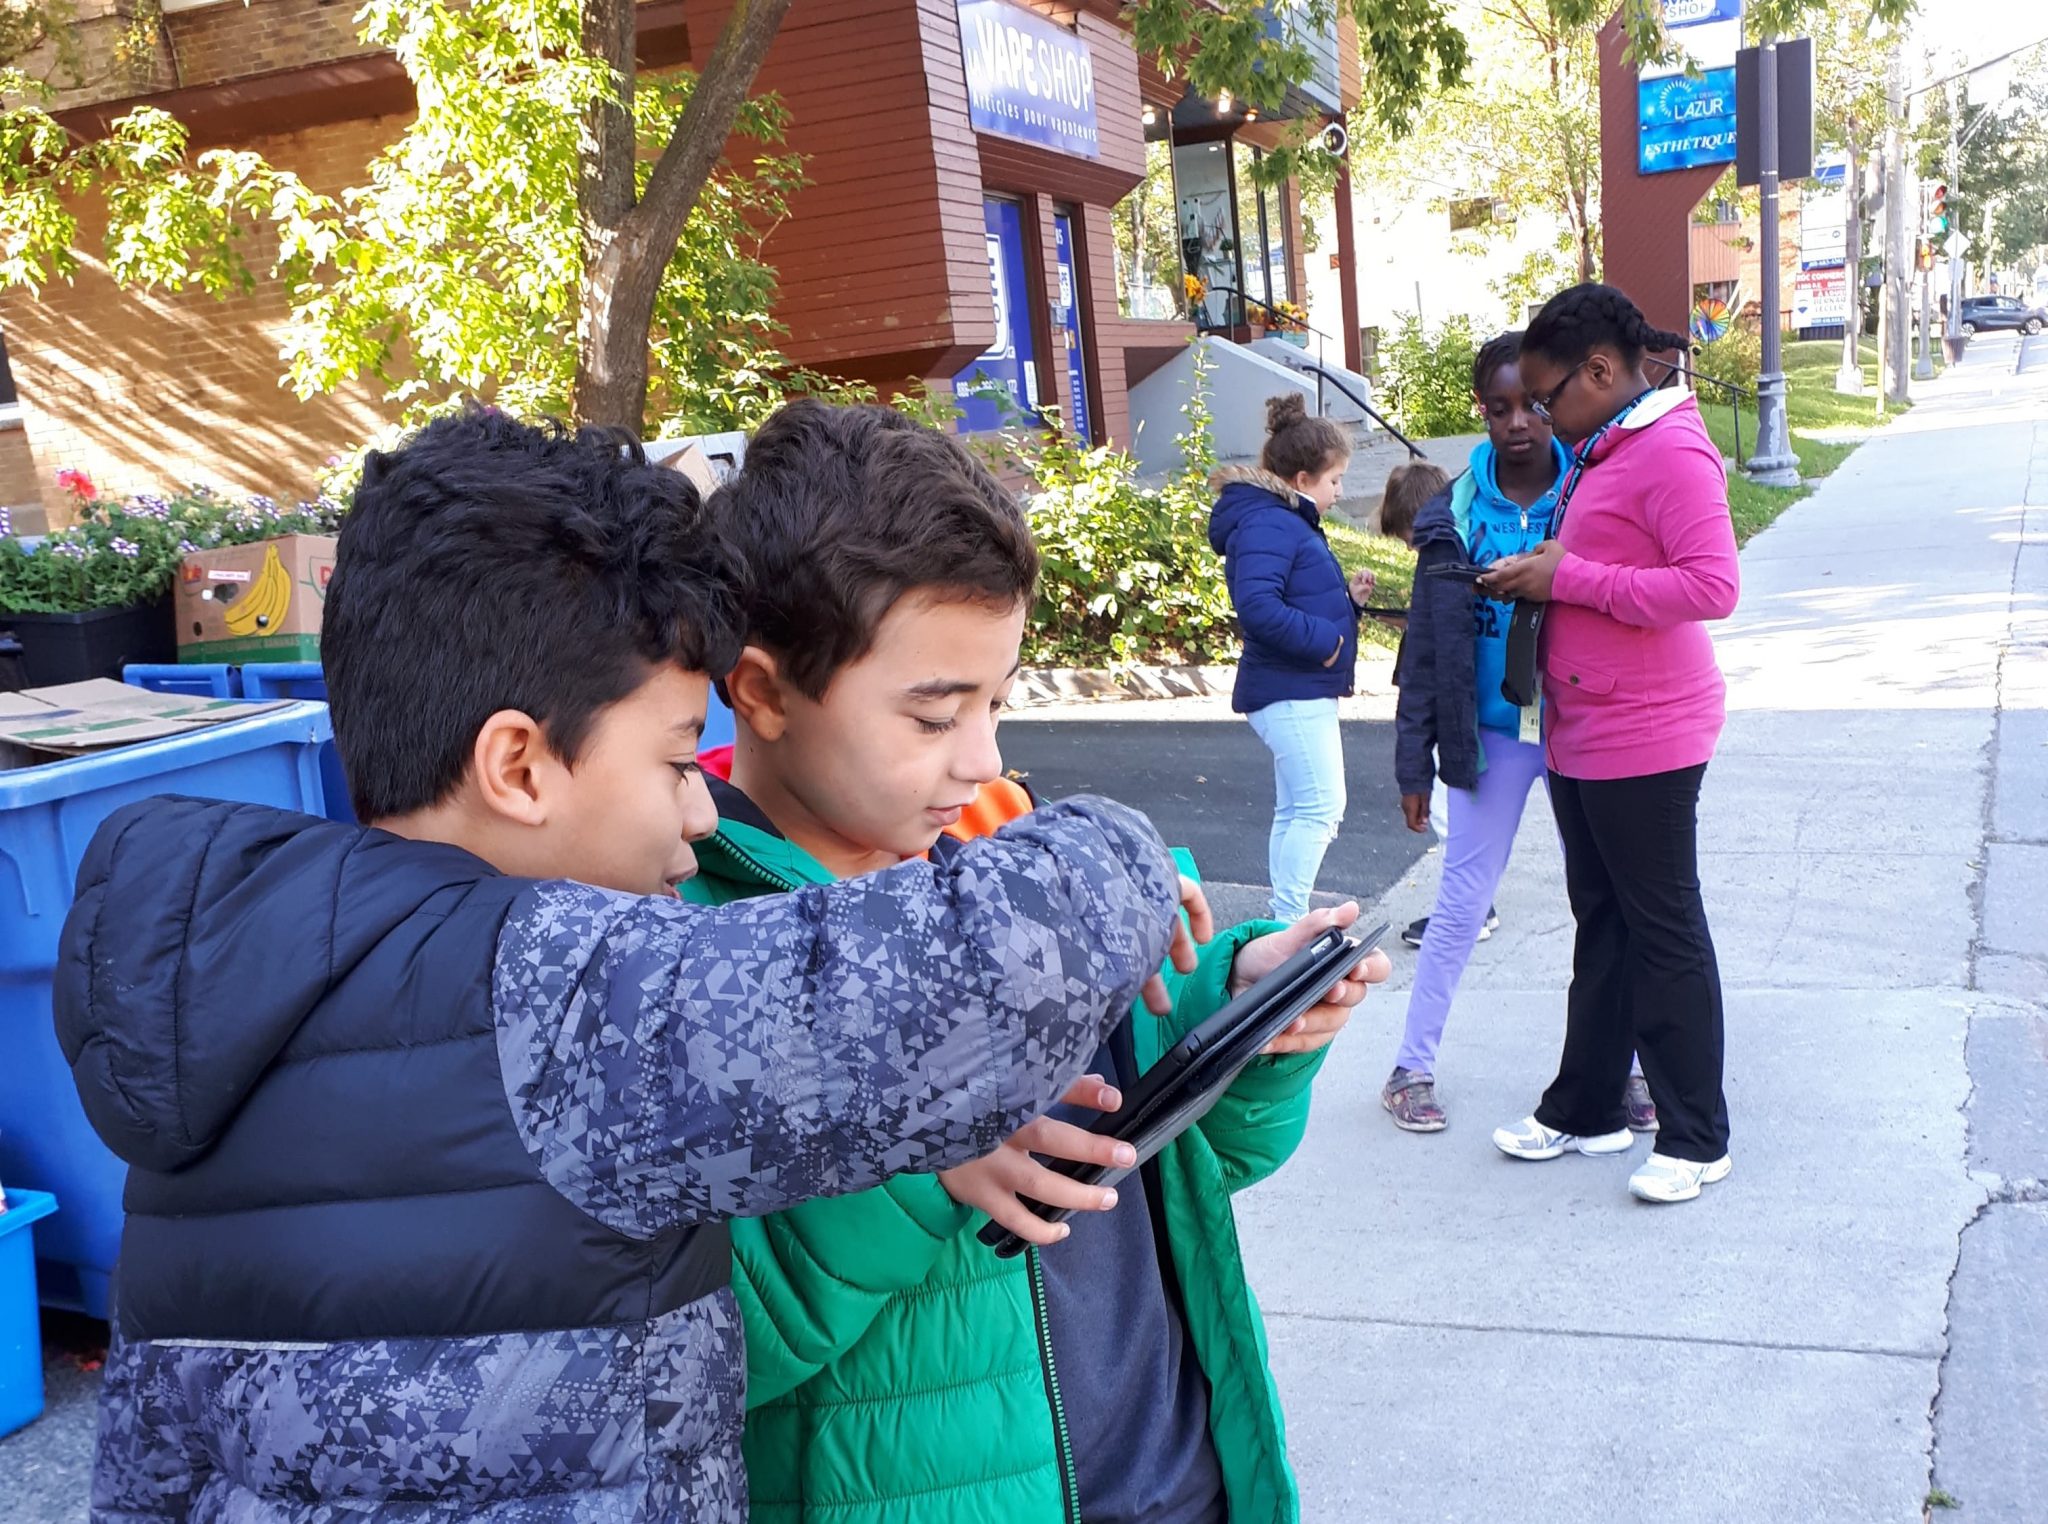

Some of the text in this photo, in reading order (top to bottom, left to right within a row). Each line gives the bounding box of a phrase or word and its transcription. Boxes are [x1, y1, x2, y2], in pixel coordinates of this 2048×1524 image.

[975, 14, 1039, 96] VAPE
[1037, 39, 1092, 112] SHOP
[973, 89, 1098, 142] Articles pour vapoteurs
[1674, 97, 1724, 120] L'AZUR
